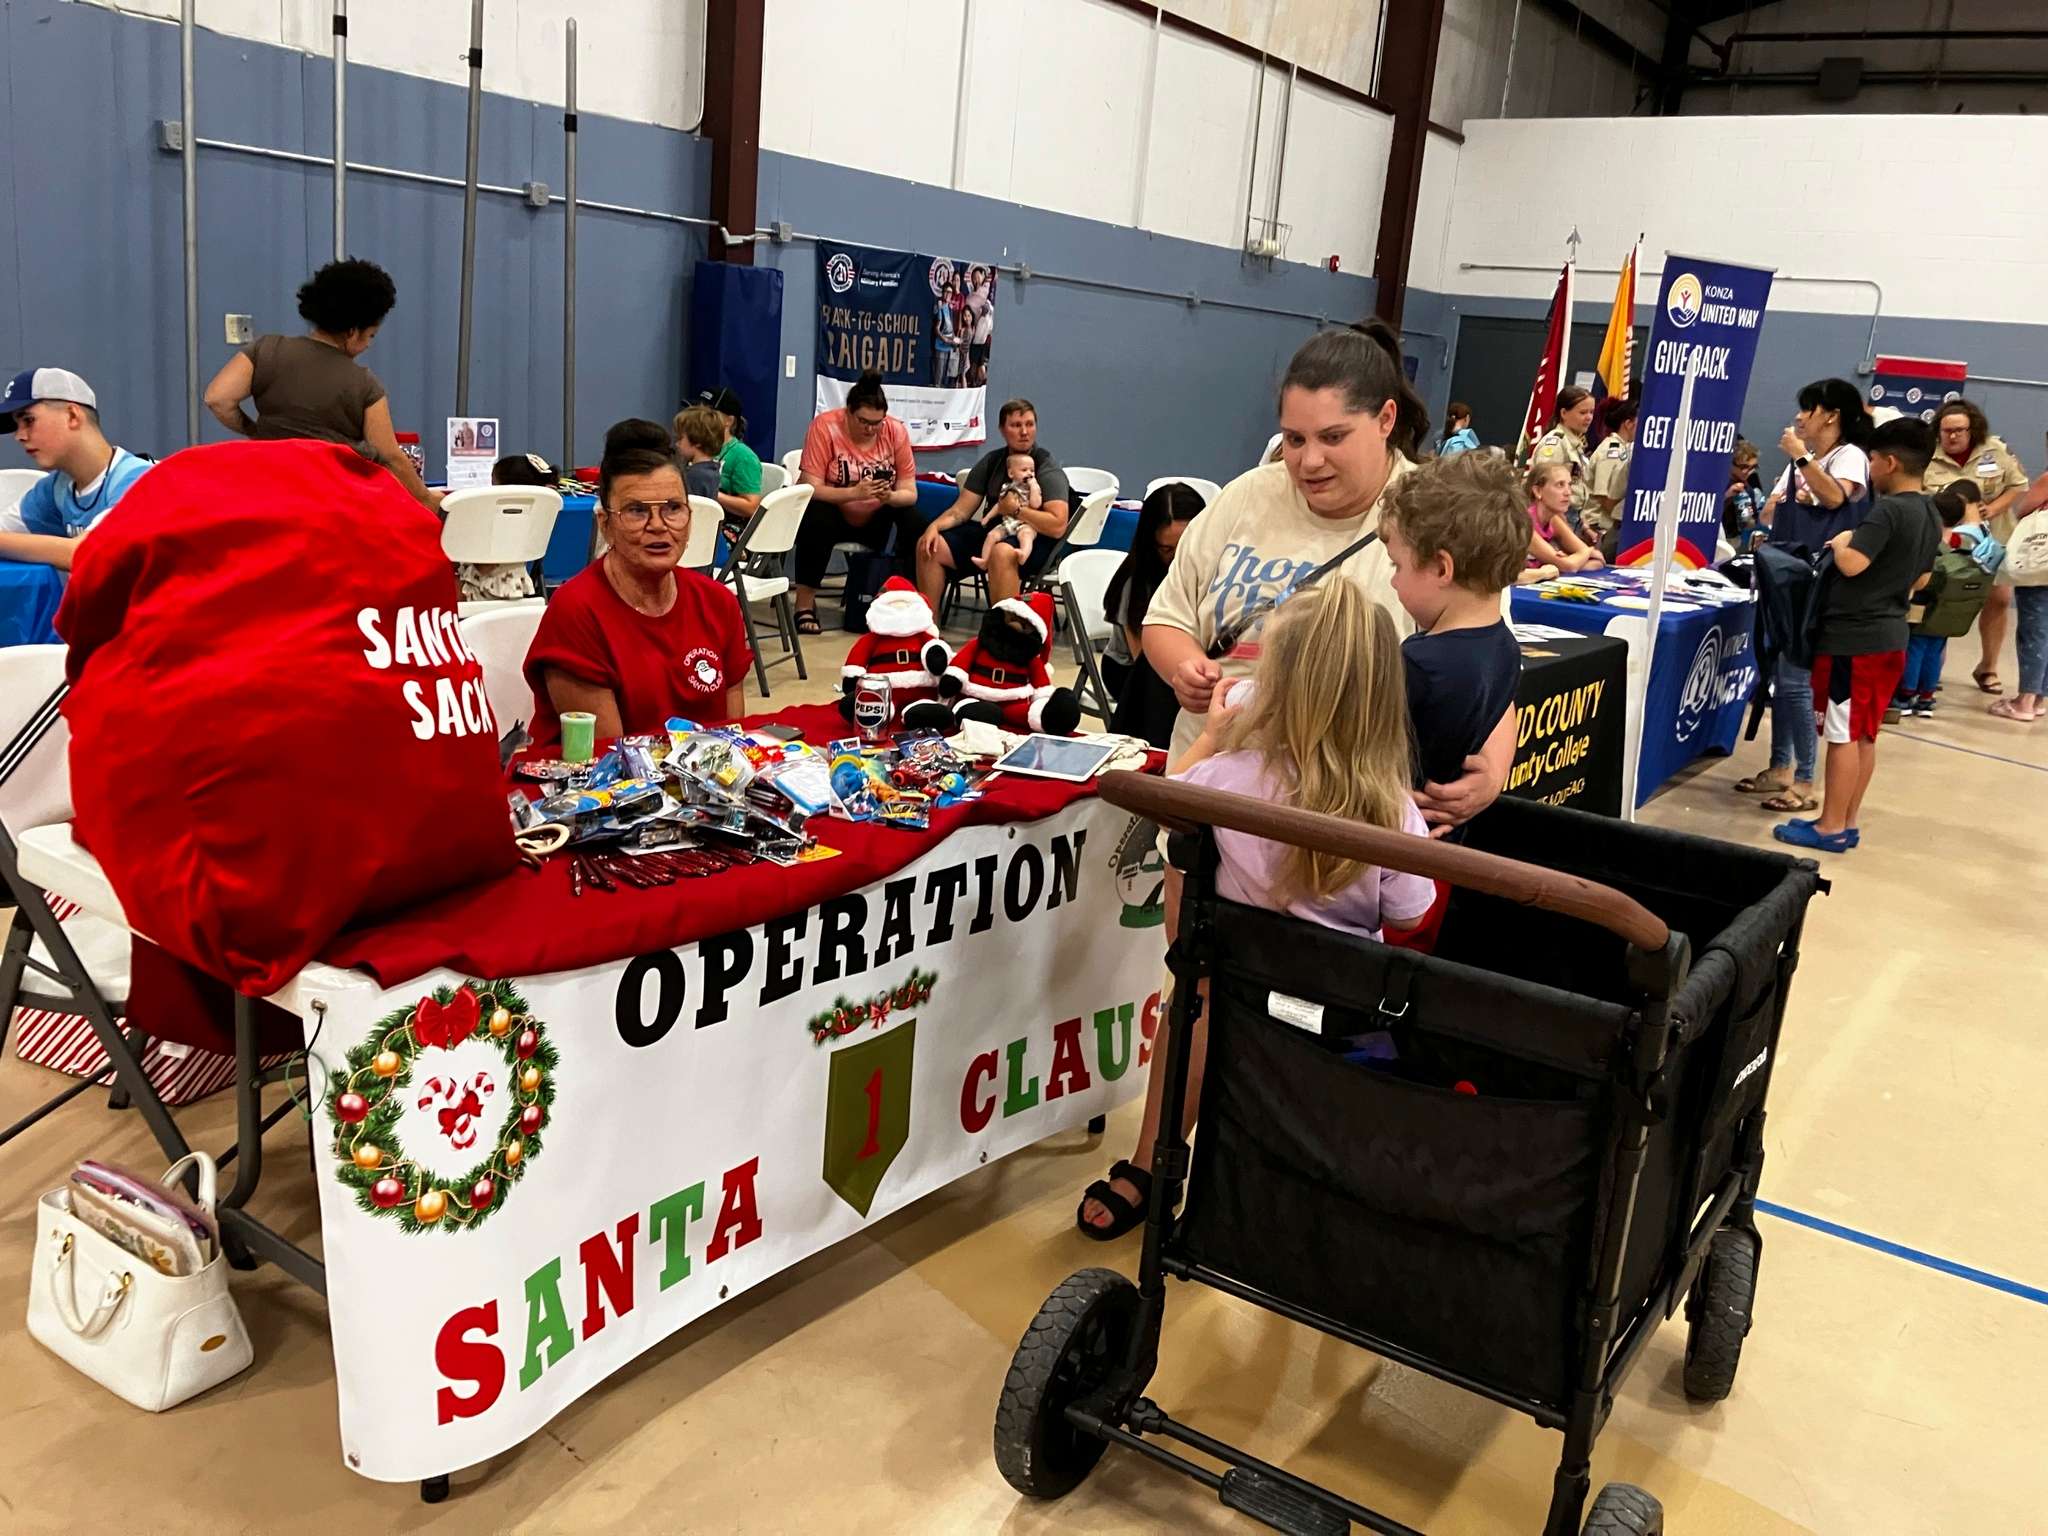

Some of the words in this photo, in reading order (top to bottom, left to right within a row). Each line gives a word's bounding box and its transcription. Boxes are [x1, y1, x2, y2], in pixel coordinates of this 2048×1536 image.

[1705, 285, 1734, 300] KONZA
[822, 304, 920, 336] BACK-TO-SCHOOL
[1701, 303, 1736, 326] UNITED
[1737, 308, 1760, 329] WAY
[1654, 339, 1690, 375] GIVE
[1693, 344, 1730, 380] BACK.
[1642, 415, 1671, 449] GET
[1671, 418, 1735, 453] IVOLVED.
[1633, 489, 1666, 522] TAK
[1678, 491, 1716, 523] CTION.
[683, 647, 719, 667] OPERATION
[687, 675, 710, 693] SANTA
[402, 677, 494, 741] SACK
[855, 702, 884, 714] PEPSI
[1535, 679, 1606, 739] COUNTY
[1544, 734, 1590, 773] College
[615, 828, 1087, 1049] OPERATION
[959, 988, 1162, 1134] CLAUS
[857, 1066, 884, 1162] 1
[434, 1155, 764, 1427] SANTA
